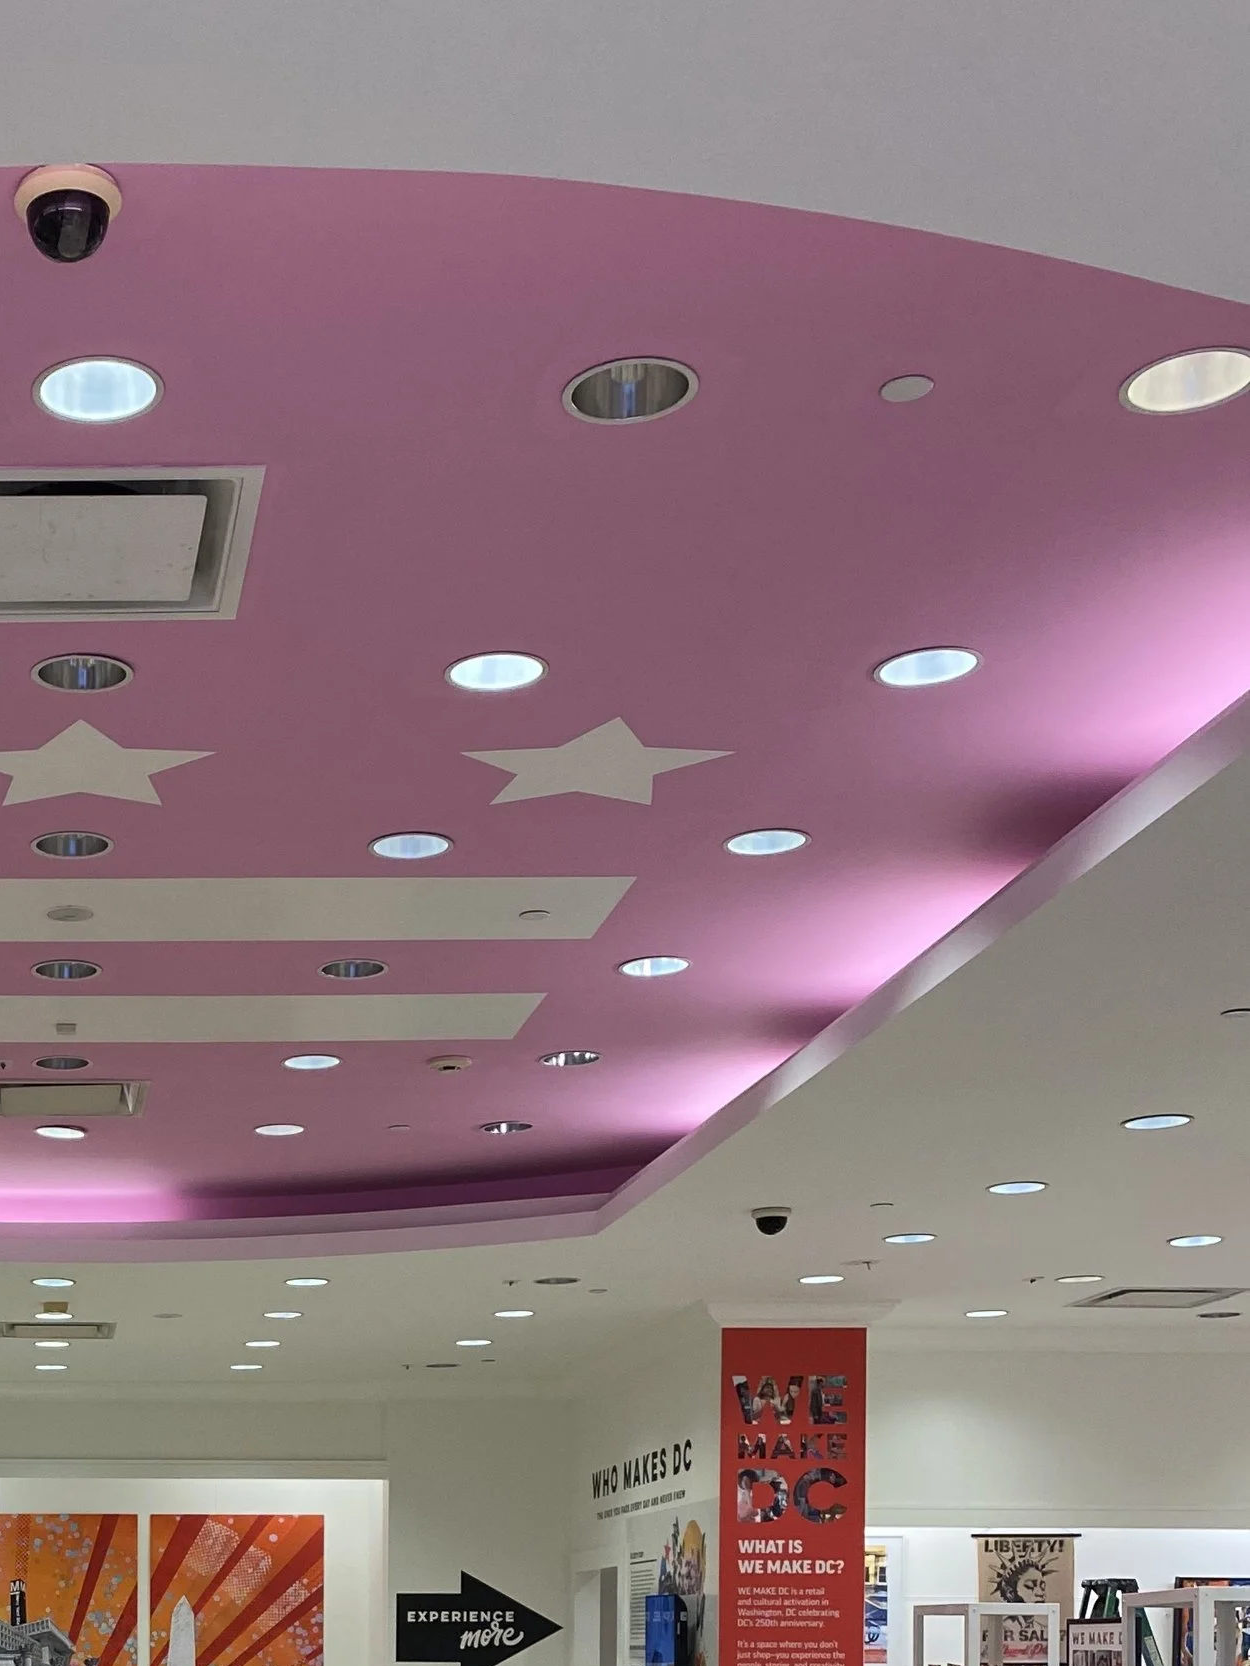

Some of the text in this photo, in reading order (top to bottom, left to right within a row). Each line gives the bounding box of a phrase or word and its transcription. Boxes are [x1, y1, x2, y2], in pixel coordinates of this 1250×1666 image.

[732, 1375, 848, 1425] WE
[737, 1433, 847, 1459] MAKE
[592, 1438, 692, 1500] WHO MAKES DC
[651, 1497, 659, 1506] AND
[737, 1467, 848, 1525] DC
[737, 1540, 803, 1554] WHAT IS
[984, 1540, 1064, 1553] LIBERTY!
[737, 1560, 845, 1574] WE MAKE DC?
[738, 1587, 750, 1595] WE
[753, 1587, 776, 1595] MAKE
[778, 1587, 789, 1595] DC
[791, 1587, 797, 1595] is
[805, 1587, 825, 1595] retail
[737, 1598, 829, 1606] and cultural activation in
[407, 1611, 515, 1622] EXPERIENCE
[738, 1609, 784, 1618] Washington,
[798, 1609, 840, 1618] celebrating
[737, 1619, 824, 1628] DC's 250th anniversary.
[459, 1621, 524, 1650] more
[982, 1630, 1066, 1642] FR SAL?
[1072, 1632, 1085, 1645] WE
[1089, 1631, 1114, 1645] MAKE
[756, 1642, 778, 1650] space
[804, 1642, 818, 1650] you
[819, 1640, 838, 1648] don't
[737, 1651, 751, 1659] just
[791, 1652, 832, 1660] experience
[832, 1651, 845, 1659] the
